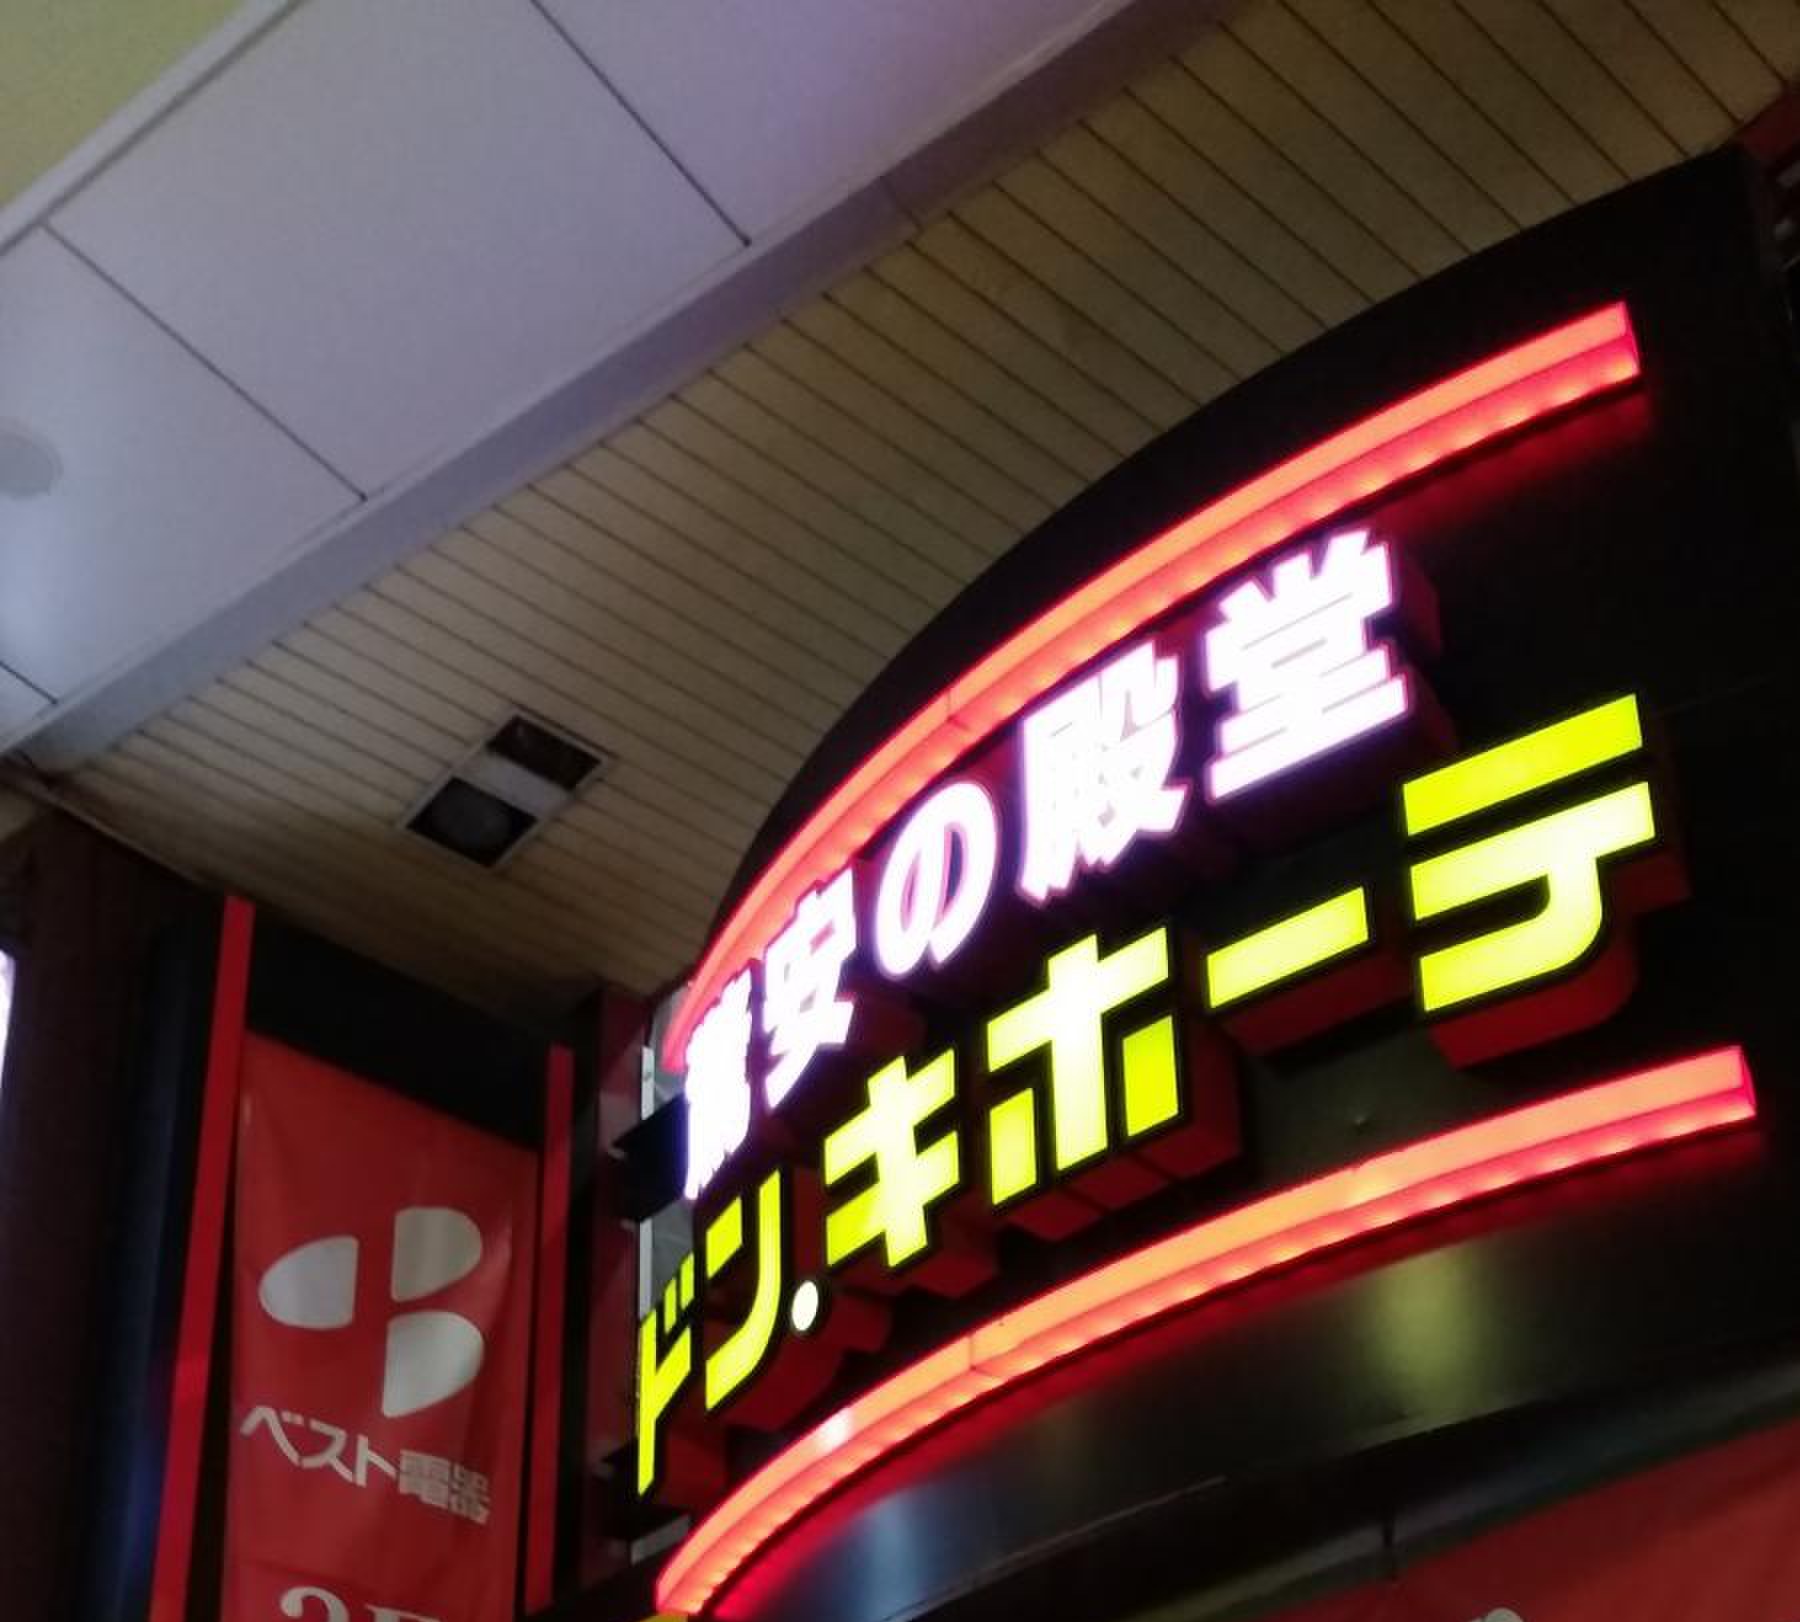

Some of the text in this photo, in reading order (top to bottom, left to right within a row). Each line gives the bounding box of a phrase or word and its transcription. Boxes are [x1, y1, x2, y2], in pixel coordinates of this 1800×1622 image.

[683, 528, 1409, 1199] 驚安の殿堂
[240, 1406, 490, 1526] ベスト電器
